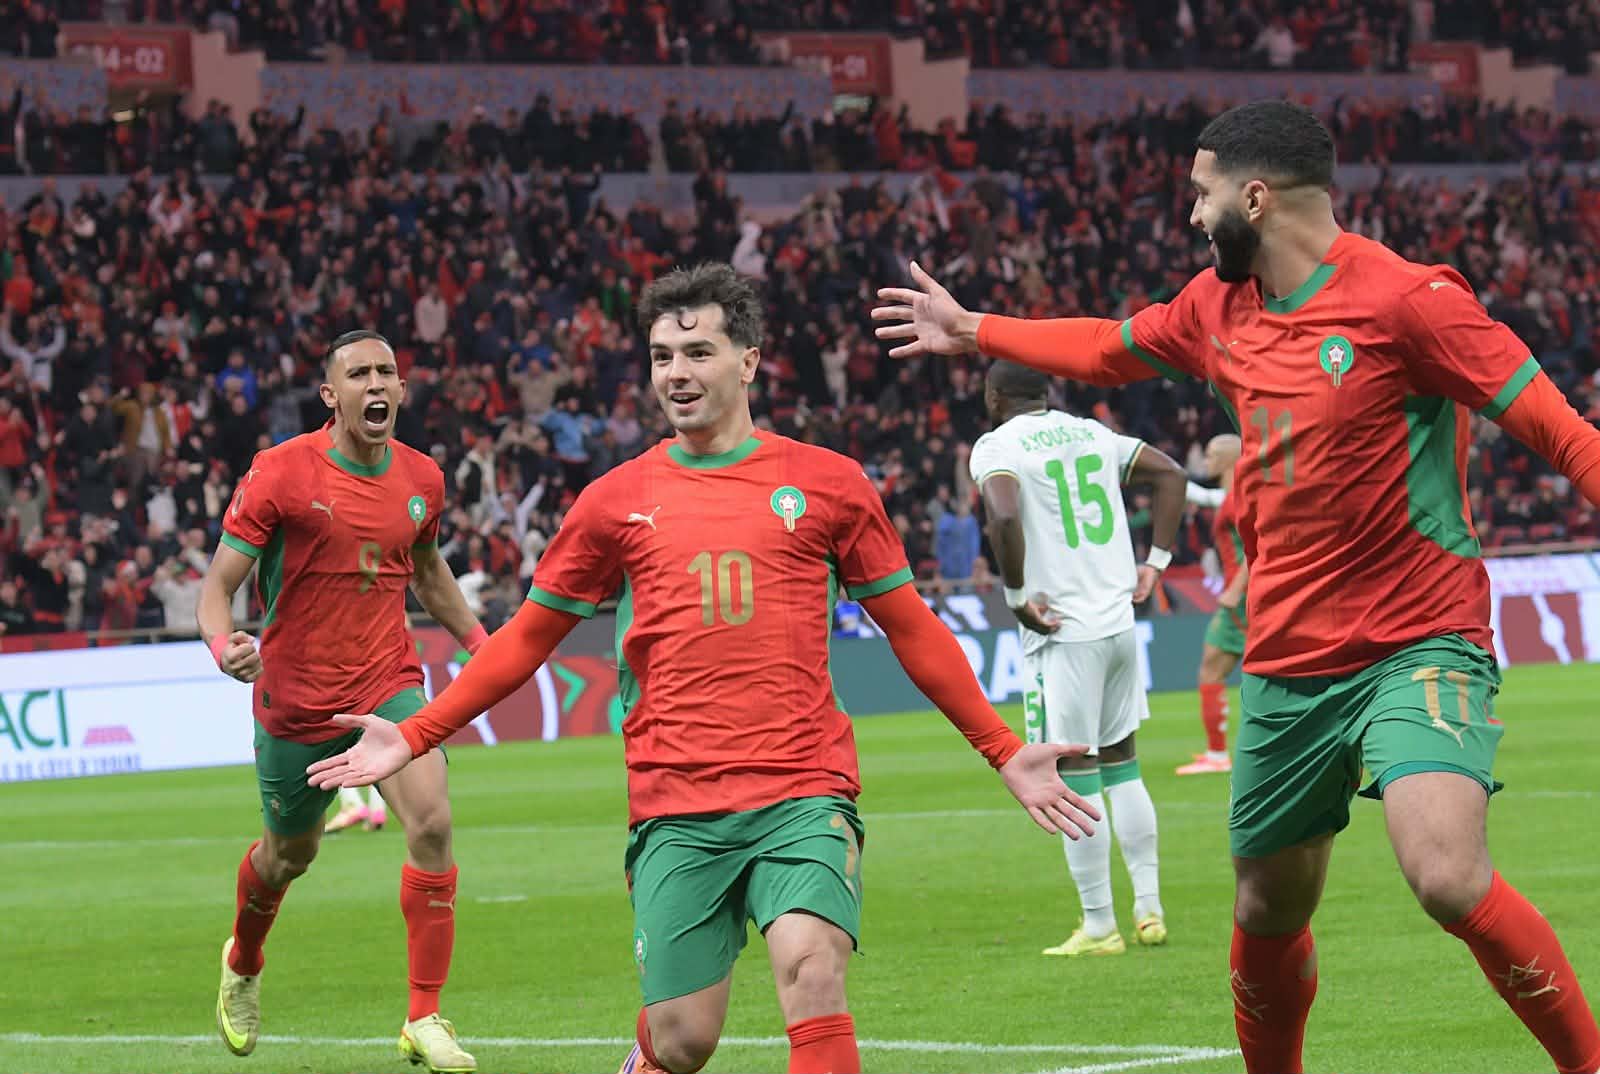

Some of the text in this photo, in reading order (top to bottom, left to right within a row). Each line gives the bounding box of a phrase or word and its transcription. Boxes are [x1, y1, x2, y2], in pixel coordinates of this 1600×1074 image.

[1251, 406, 1295, 486] 11
[1045, 454, 1114, 549] 15
[358, 542, 381, 593] 9
[687, 550, 754, 626] 10
[1411, 667, 1471, 723] 11
